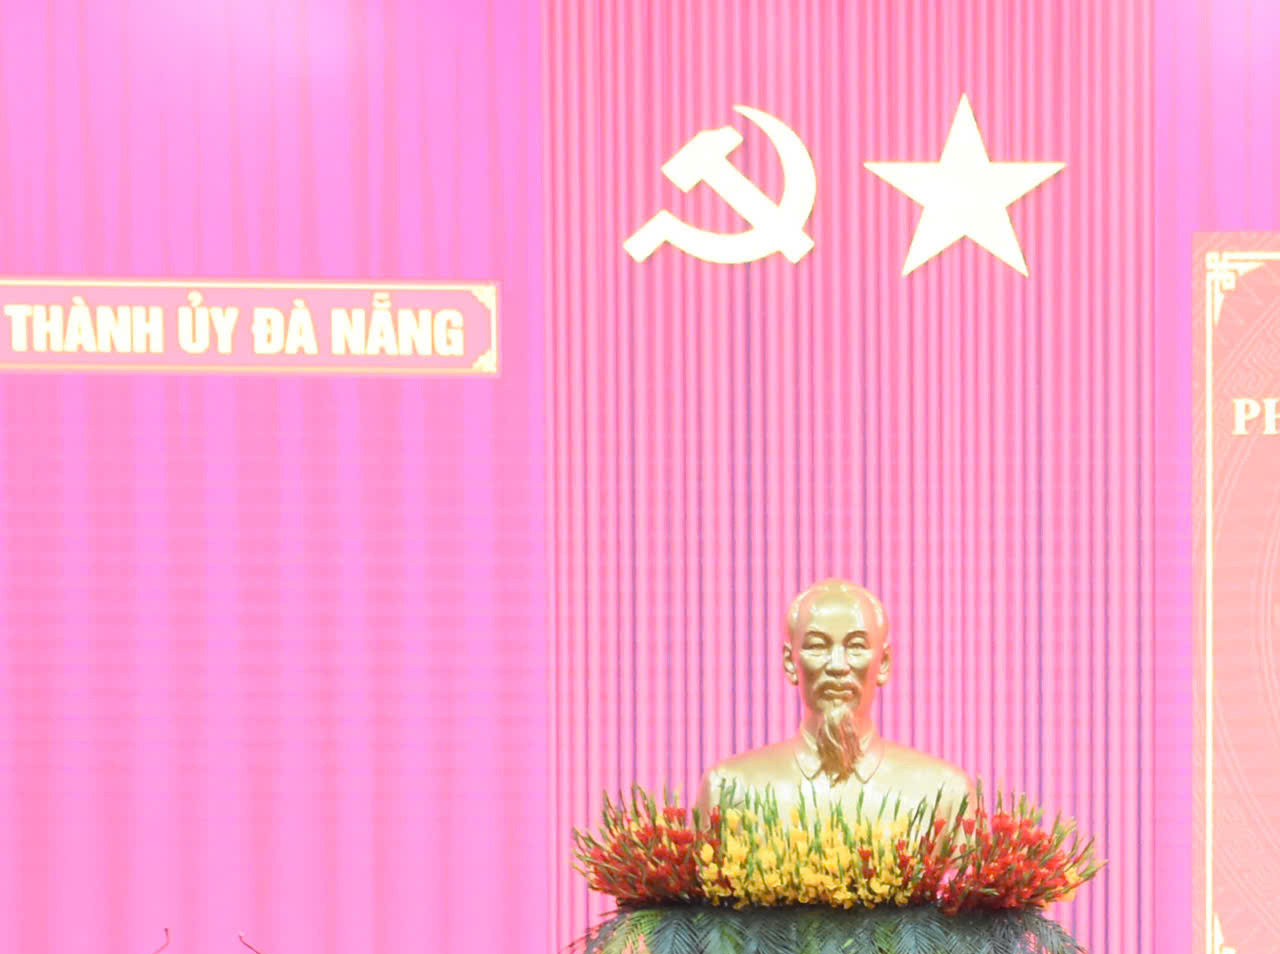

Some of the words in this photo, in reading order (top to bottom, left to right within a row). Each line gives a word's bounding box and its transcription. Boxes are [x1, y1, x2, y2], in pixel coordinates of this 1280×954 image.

[4, 296, 164, 354] THÀNH
[178, 291, 239, 354] ỦY
[251, 298, 318, 355] ĐÀ
[331, 292, 464, 356] NẴNG
